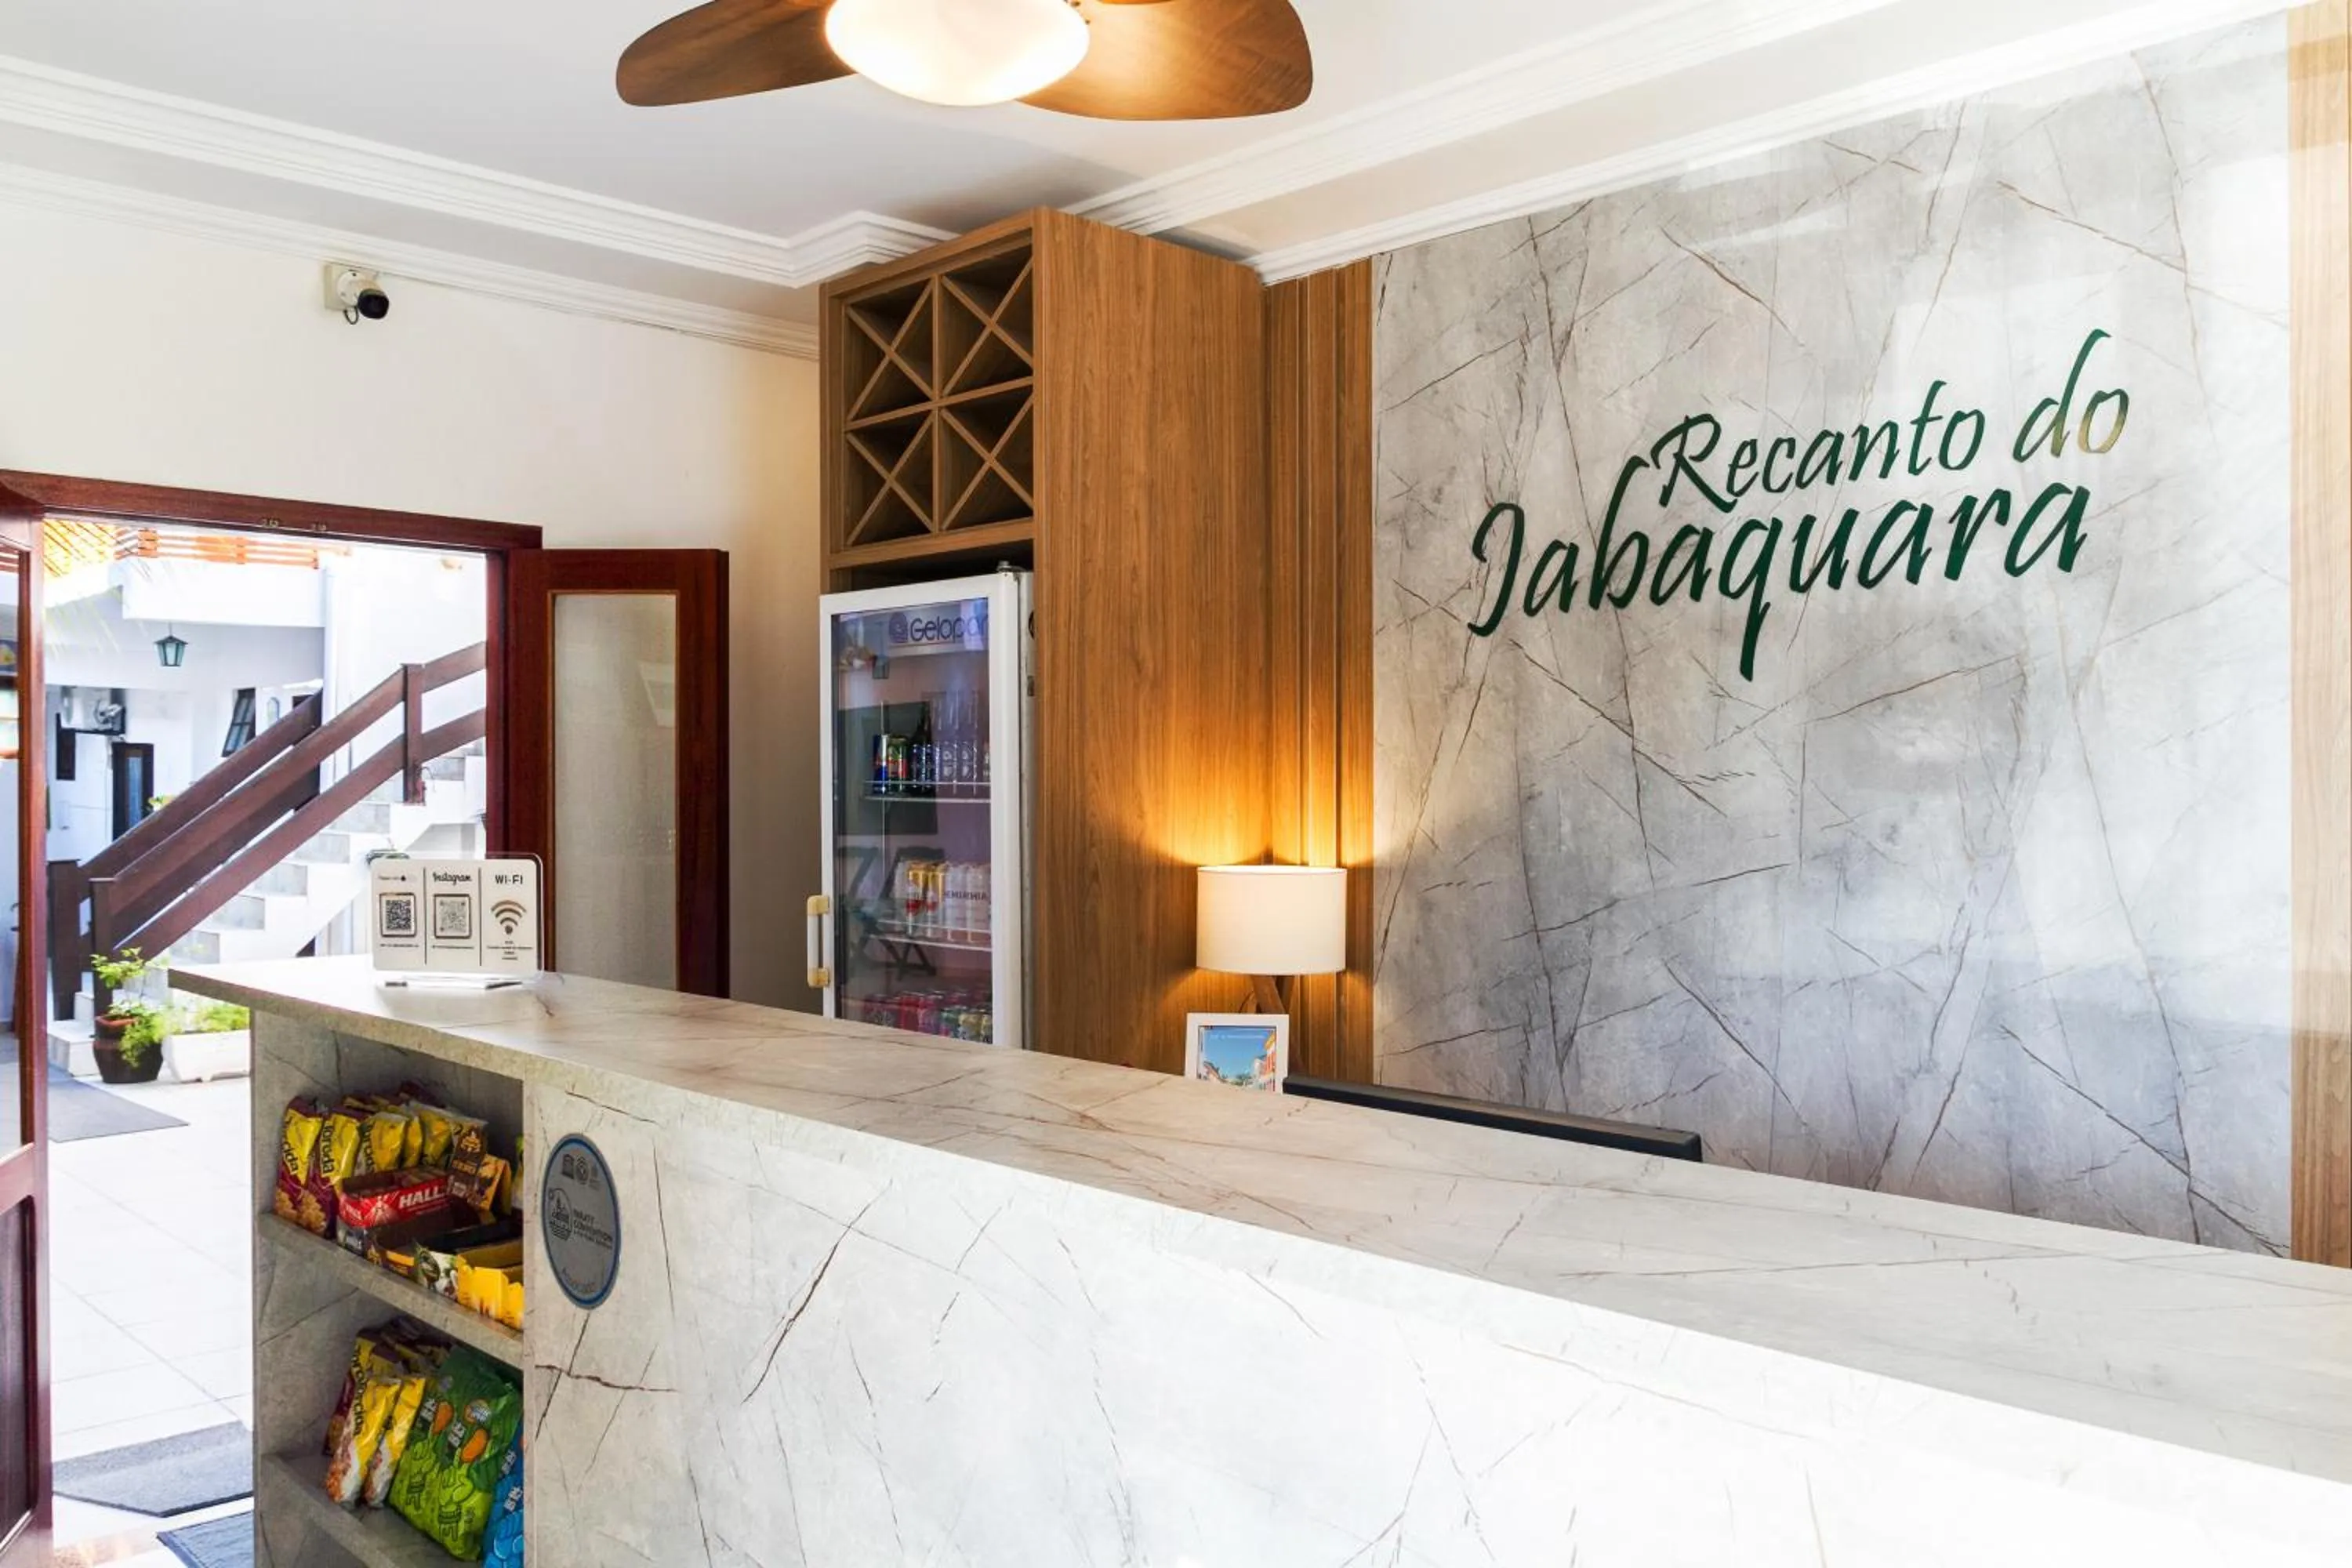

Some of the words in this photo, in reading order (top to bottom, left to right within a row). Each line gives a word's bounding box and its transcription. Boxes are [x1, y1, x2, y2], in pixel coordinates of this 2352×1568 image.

[1652, 380, 1986, 513] Recanto
[2012, 328, 2130, 464] do
[1467, 454, 2092, 682] Jabaquara
[432, 871, 473, 886] Instagram
[494, 874, 524, 885] WI-FI
[398, 1185, 445, 1209] HALL
